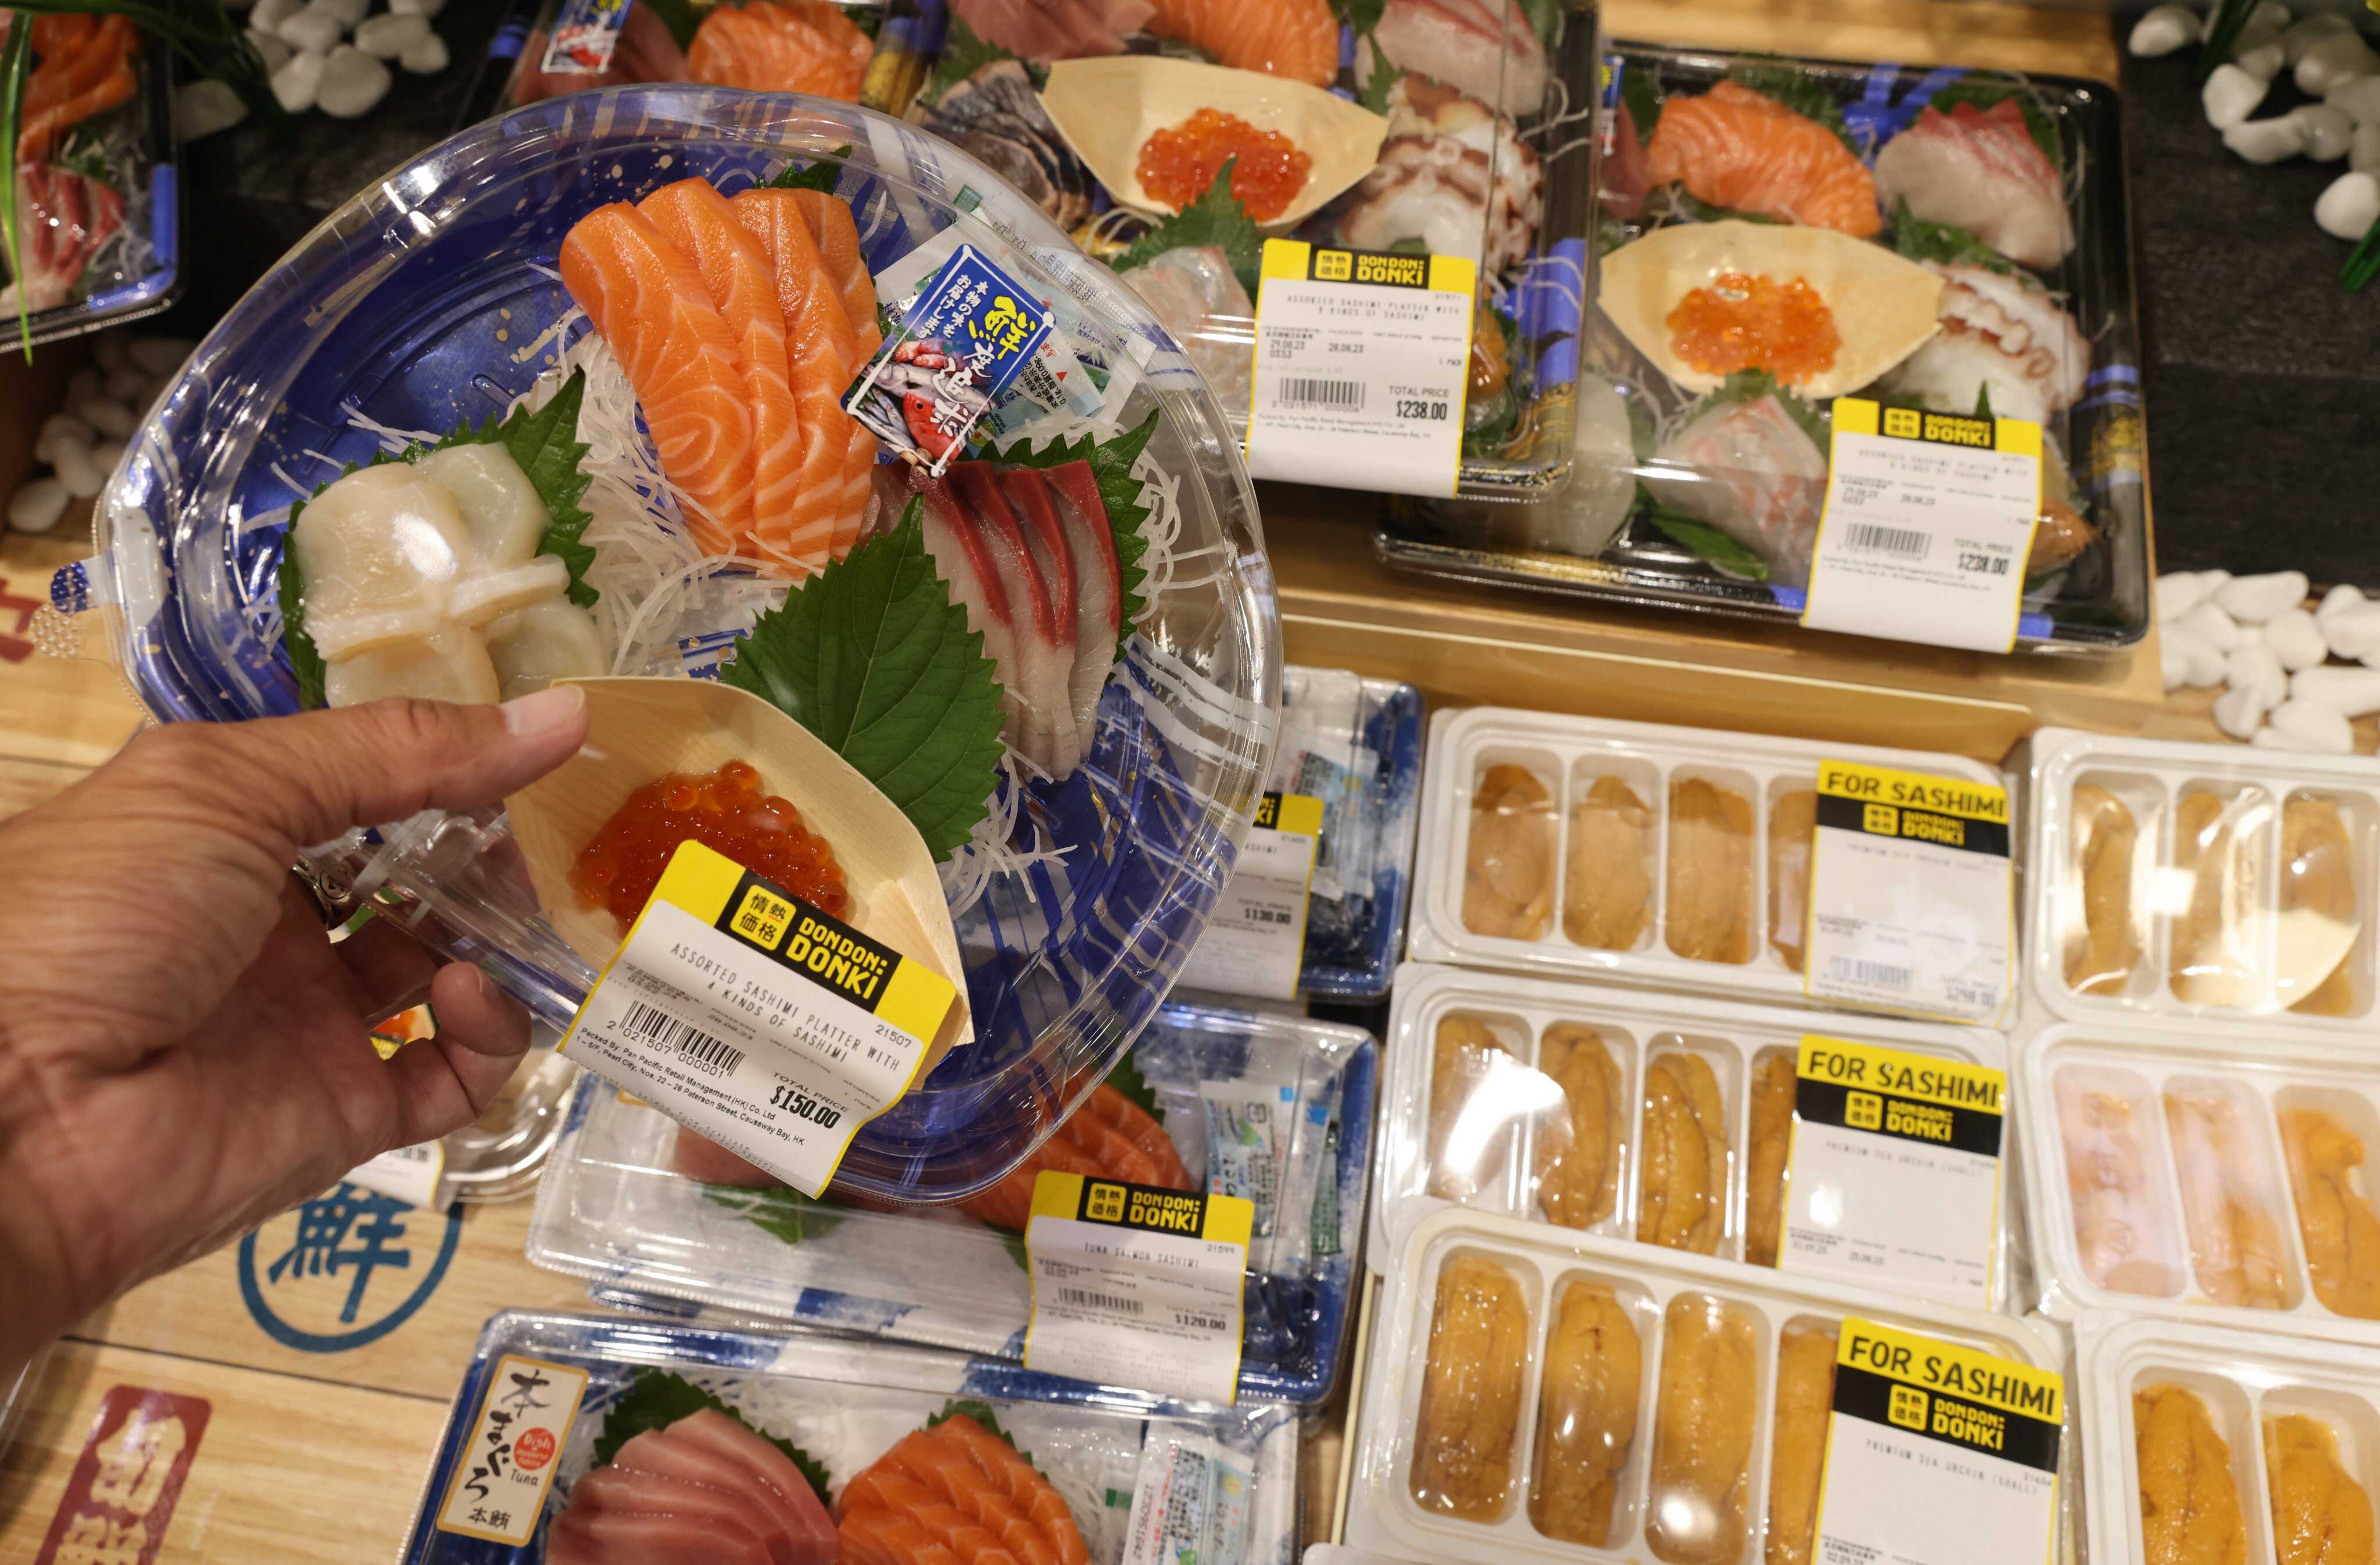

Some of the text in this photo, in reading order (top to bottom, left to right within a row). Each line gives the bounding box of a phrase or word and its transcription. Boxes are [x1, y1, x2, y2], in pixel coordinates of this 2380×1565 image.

[1357, 266, 1423, 285] DONKI
[917, 274, 971, 339] お届けします
[943, 281, 988, 338] 本物の味を
[1389, 385, 1450, 399] TOTAL PRICE
[1397, 400, 1447, 420] $238.00
[1827, 772, 2005, 818] FOR SASHIMI
[740, 912, 777, 943] 価格
[786, 933, 879, 1000] DONKI
[671, 943, 737, 984] ASSORTED
[744, 981, 799, 1018] SASHIMI
[806, 1015, 861, 1051] PLATTER
[867, 1046, 900, 1071] WITH
[707, 982, 715, 990] 4
[722, 990, 763, 1016] KINDS
[770, 1015, 787, 1029] OF
[793, 1027, 847, 1062] SASHIMI
[607, 1020, 617, 1030] 2
[622, 1028, 672, 1055] 021507
[678, 1052, 724, 1079] 000001
[875, 1024, 912, 1048] 21507
[581, 1027, 609, 1045] Packed
[622, 1048, 637, 1059] Pan
[639, 1055, 663, 1072] Pacific
[665, 1067, 686, 1081] Retail
[686, 1076, 731, 1102] Management
[731, 1095, 749, 1110] (HK)
[749, 1104, 761, 1115] Co.
[762, 1110, 776, 1120] Ltd
[773, 1072, 850, 1112] TOTAL PRICE
[1809, 1051, 1998, 1107] FOR SASHIMI
[602, 1049, 621, 1063] Pearl
[640, 1068, 655, 1079] Nos.
[657, 1076, 666, 1084] 22
[683, 1088, 715, 1107] Paterson
[715, 1103, 738, 1118] Street,
[739, 1111, 775, 1134] Causeway
[776, 1129, 791, 1141] Bay,
[793, 1136, 805, 1146] HK
[770, 1085, 841, 1129] $150.00
[1886, 1113, 1952, 1142] DONKI
[1129, 1205, 1197, 1232] DONKI
[1175, 1313, 1226, 1331] $120.00
[1850, 1335, 2055, 1416] FOR SASHIMI
[1932, 1413, 2004, 1451] DONKI
[510, 1469, 538, 1486] Tuna
[468, 1506, 511, 1530] 本鮪
